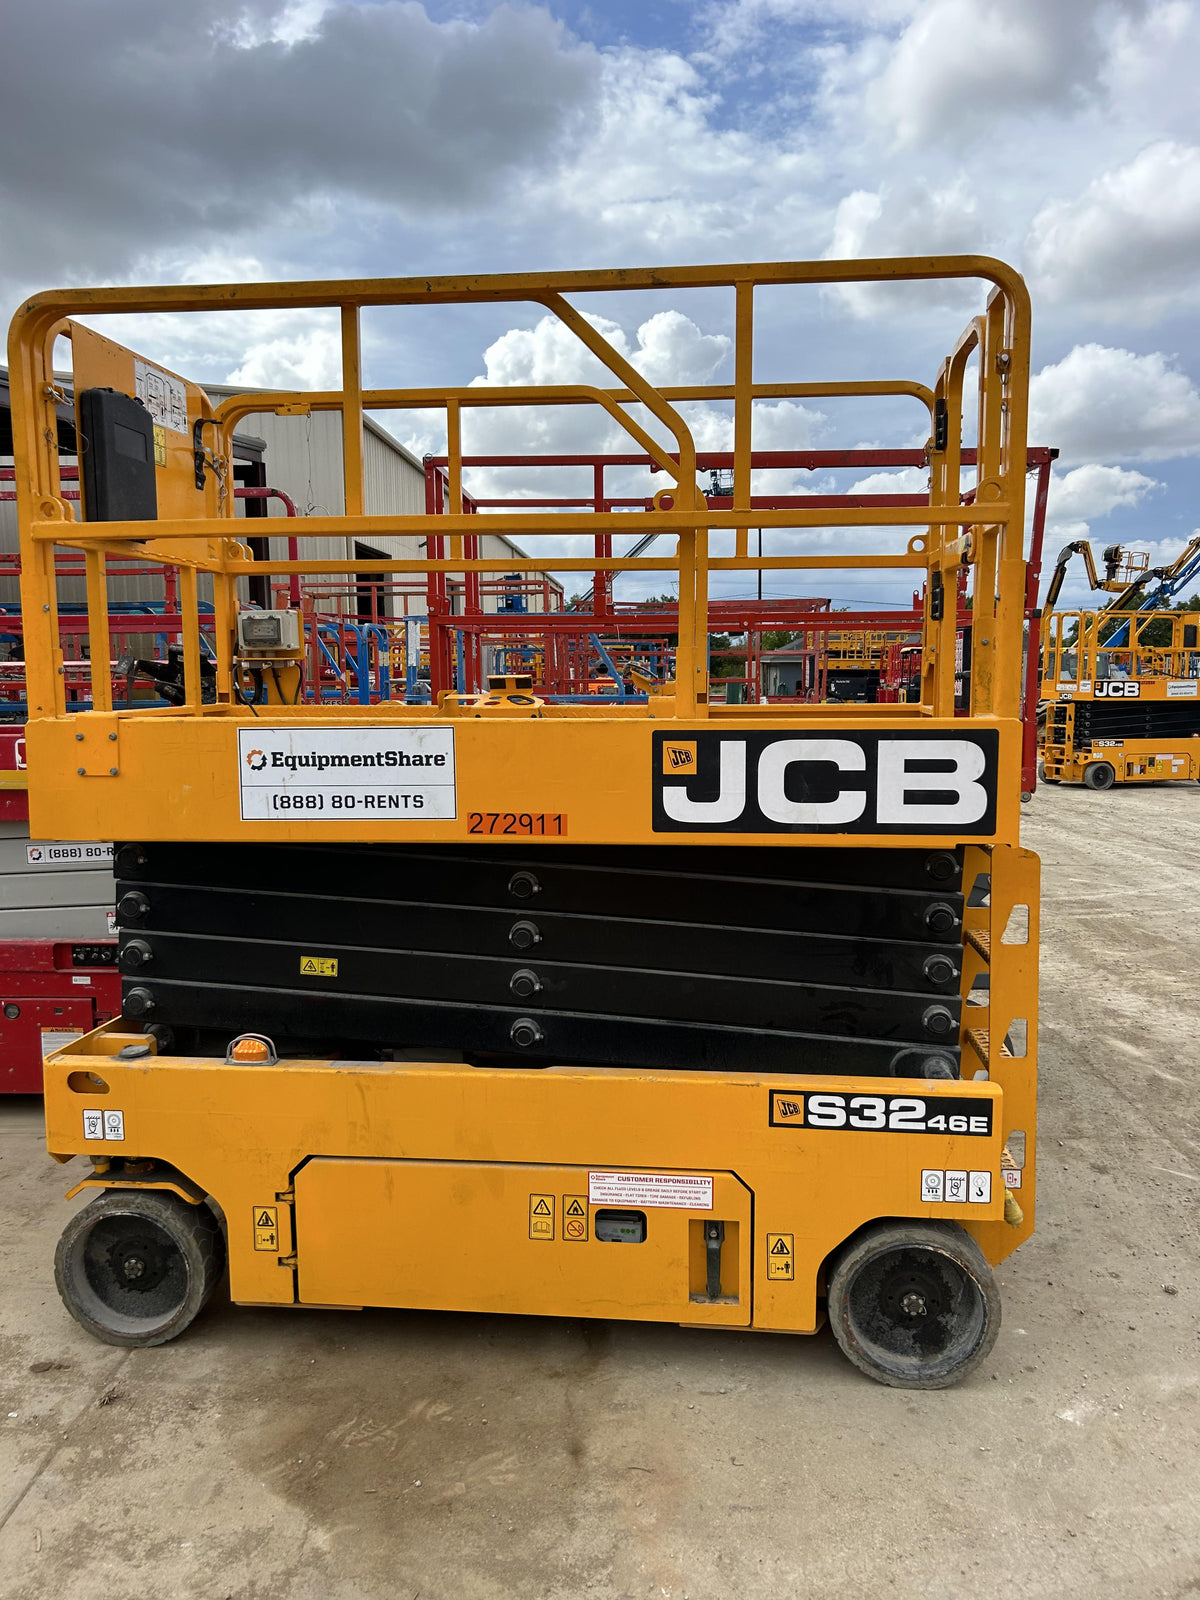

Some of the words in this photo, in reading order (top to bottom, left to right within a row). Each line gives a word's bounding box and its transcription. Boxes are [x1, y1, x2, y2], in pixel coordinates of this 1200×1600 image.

[1094, 682, 1140, 697] JCB
[271, 751, 446, 770] EquipmentShare
[671, 749, 692, 766] JCB
[662, 738, 989, 825] JCB
[273, 794, 324, 810] (888)
[331, 794, 424, 809] 80-RENTS
[469, 812, 562, 835] 272911
[49, 847, 82, 859] (888)
[781, 1100, 800, 1115] JCB
[655, 1177, 711, 1186] RESPONSIBILITY
